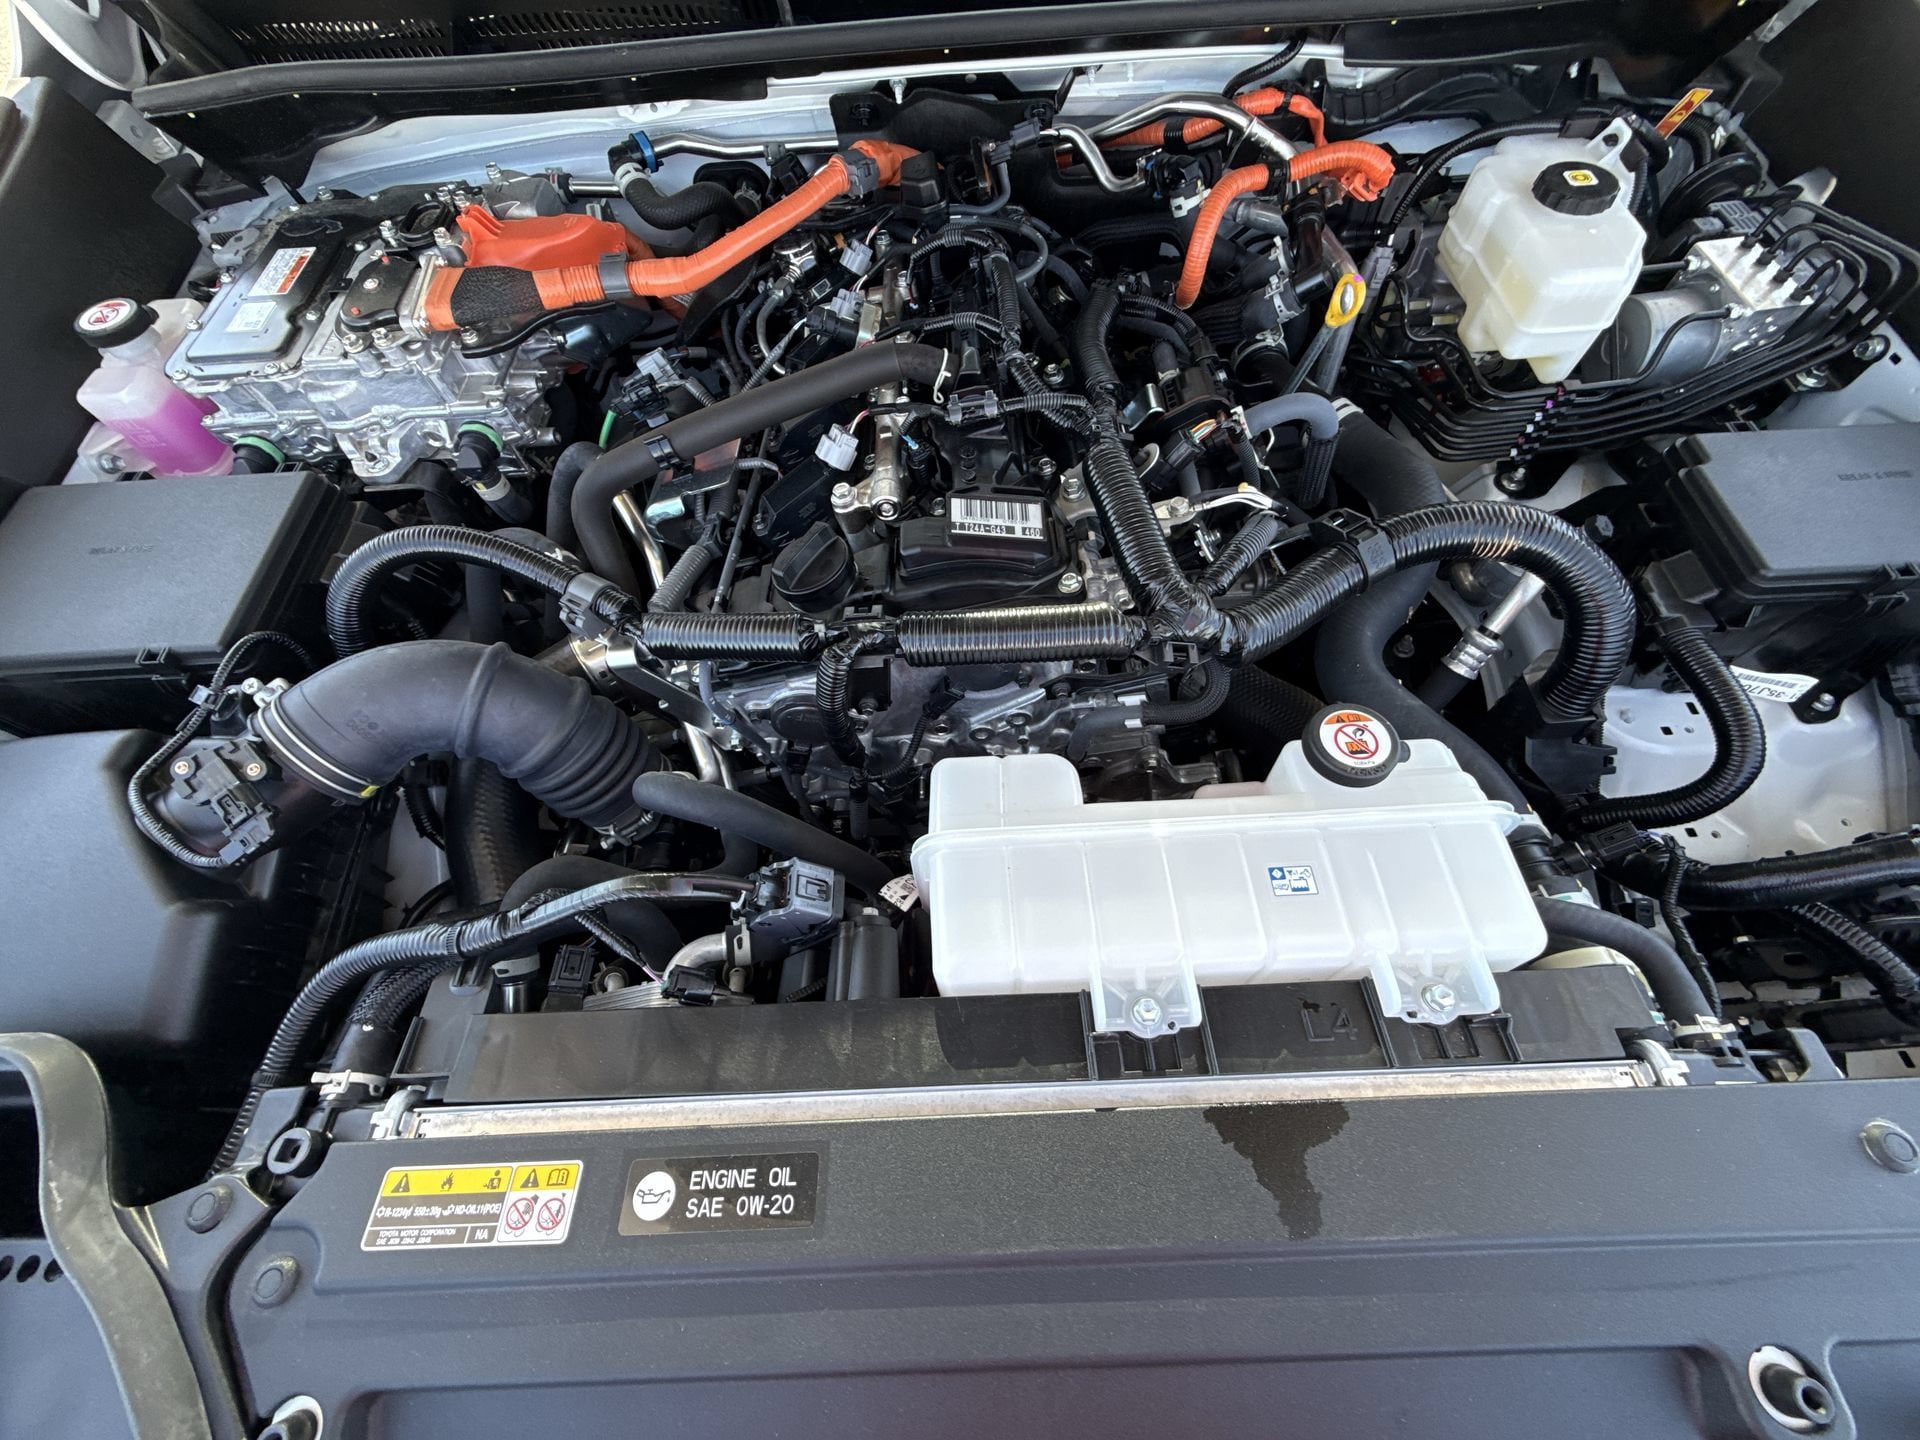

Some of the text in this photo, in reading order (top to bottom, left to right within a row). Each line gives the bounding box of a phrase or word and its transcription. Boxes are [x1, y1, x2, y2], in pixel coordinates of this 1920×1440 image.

[964, 524, 1006, 535] T24A-G43
[689, 1166, 797, 1190] ENGINE OIL
[685, 1193, 794, 1219] SAE 0W-20
[379, 1228, 457, 1238] TOYOTA MOTOR CORPORATION
[474, 1228, 489, 1240] NA
